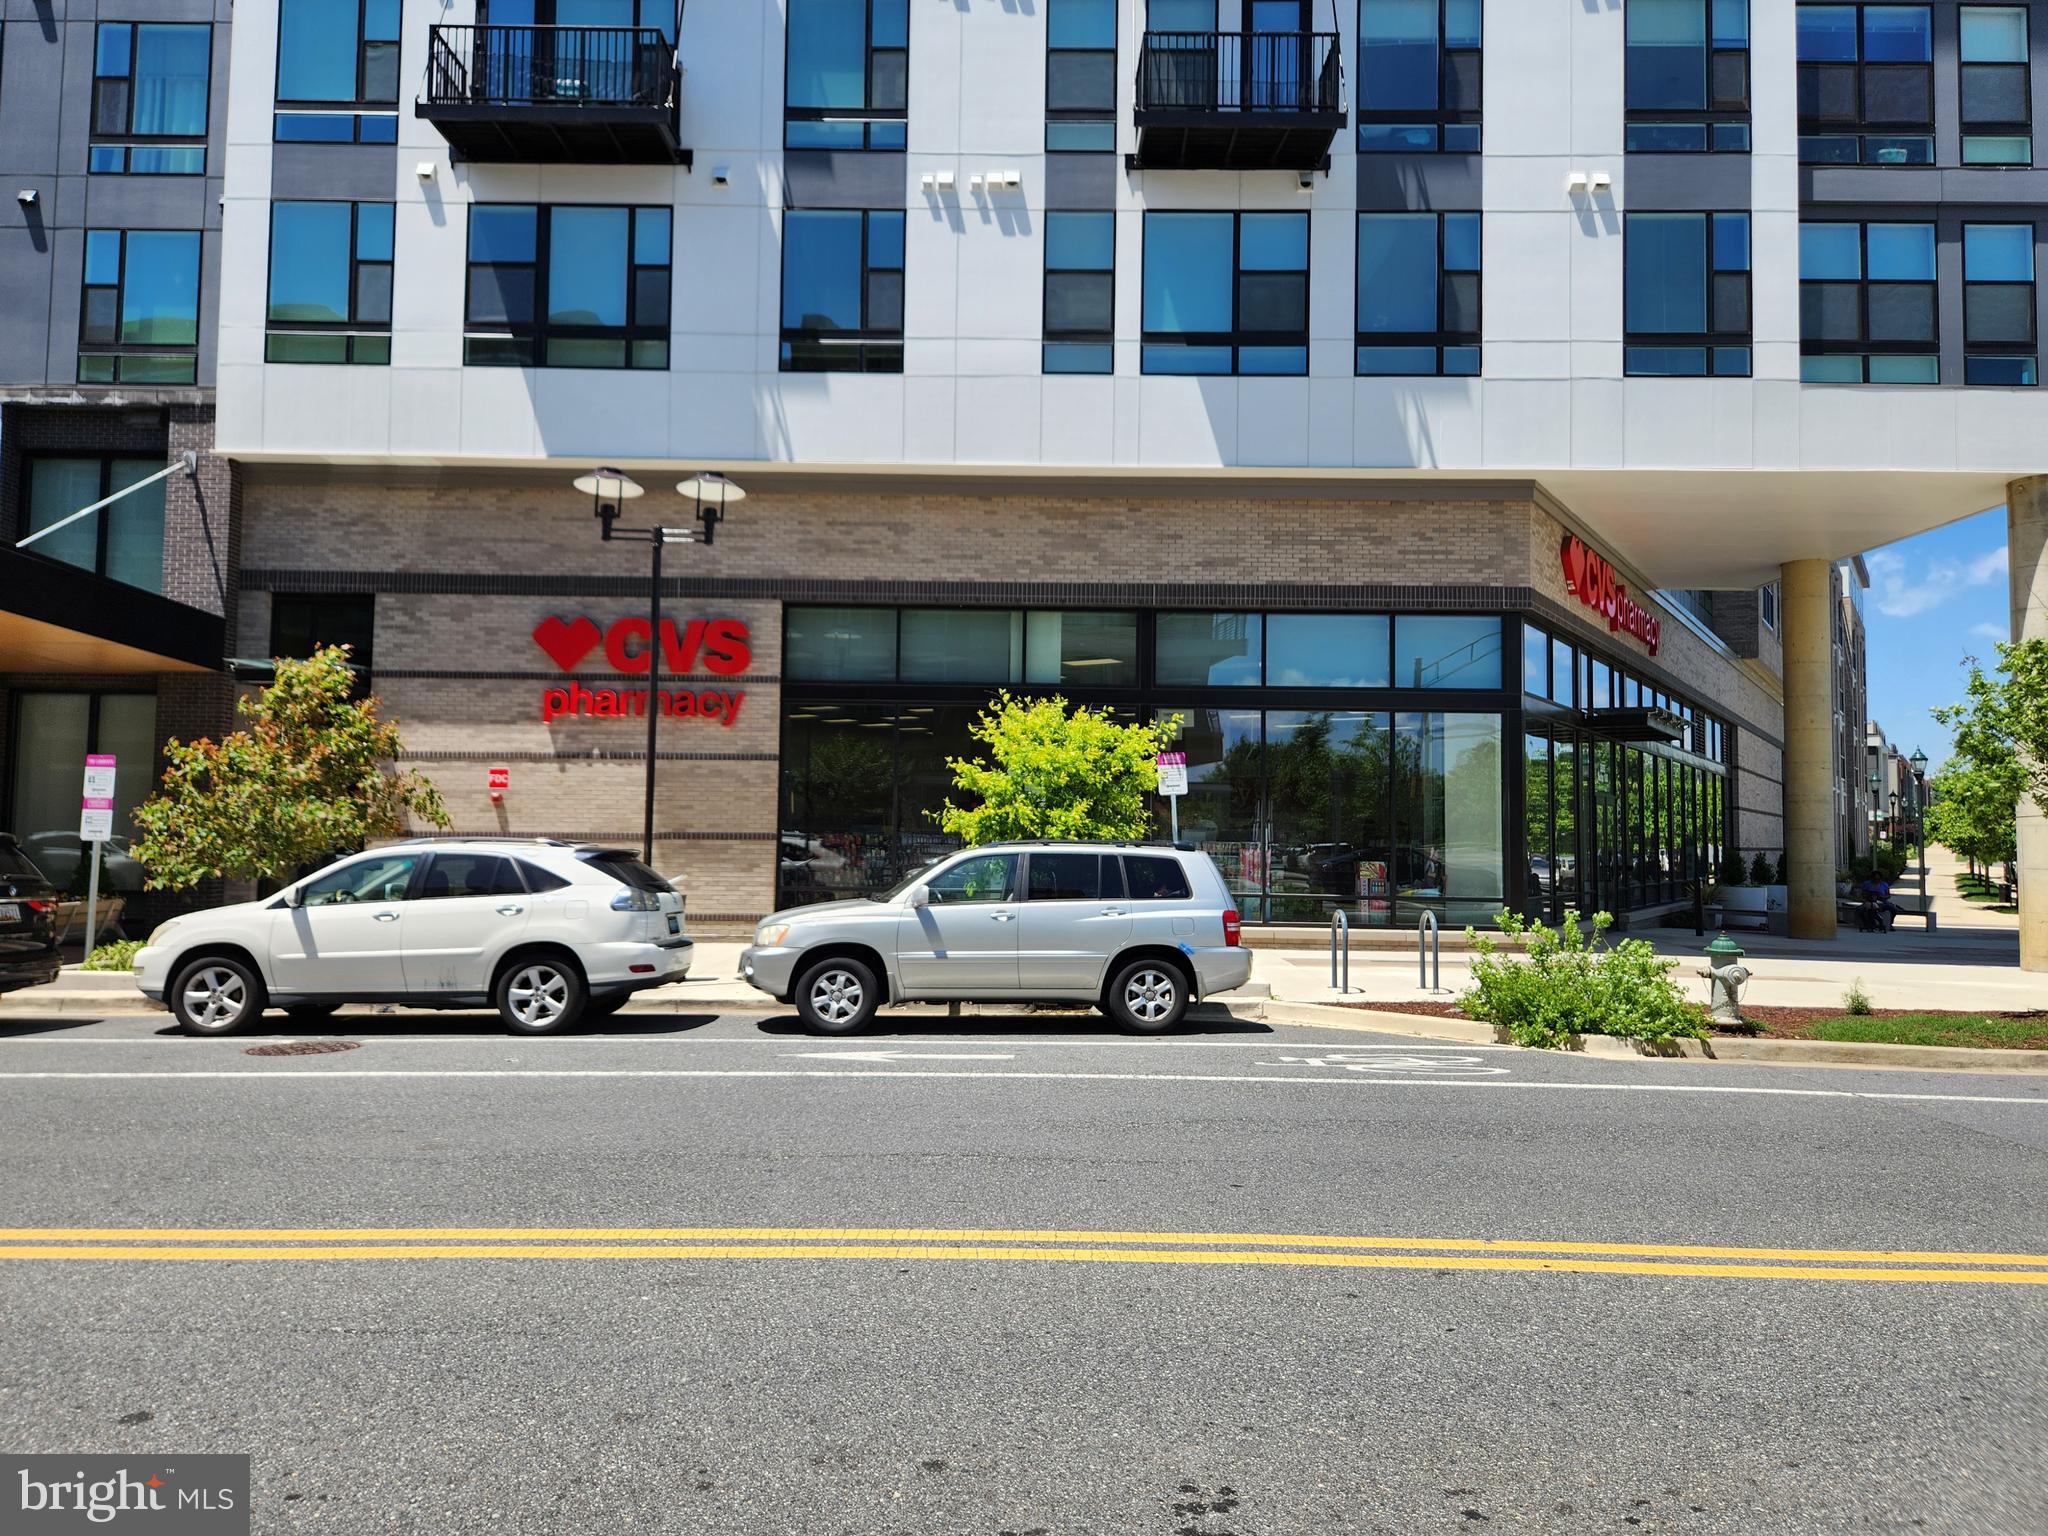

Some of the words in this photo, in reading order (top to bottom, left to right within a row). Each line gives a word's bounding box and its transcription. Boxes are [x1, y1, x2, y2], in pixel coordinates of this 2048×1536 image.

[1583, 548, 1617, 618] CVS
[604, 617, 752, 674] CVS
[1613, 588, 1660, 656] pharmacy
[542, 680, 745, 726] pharmacy
